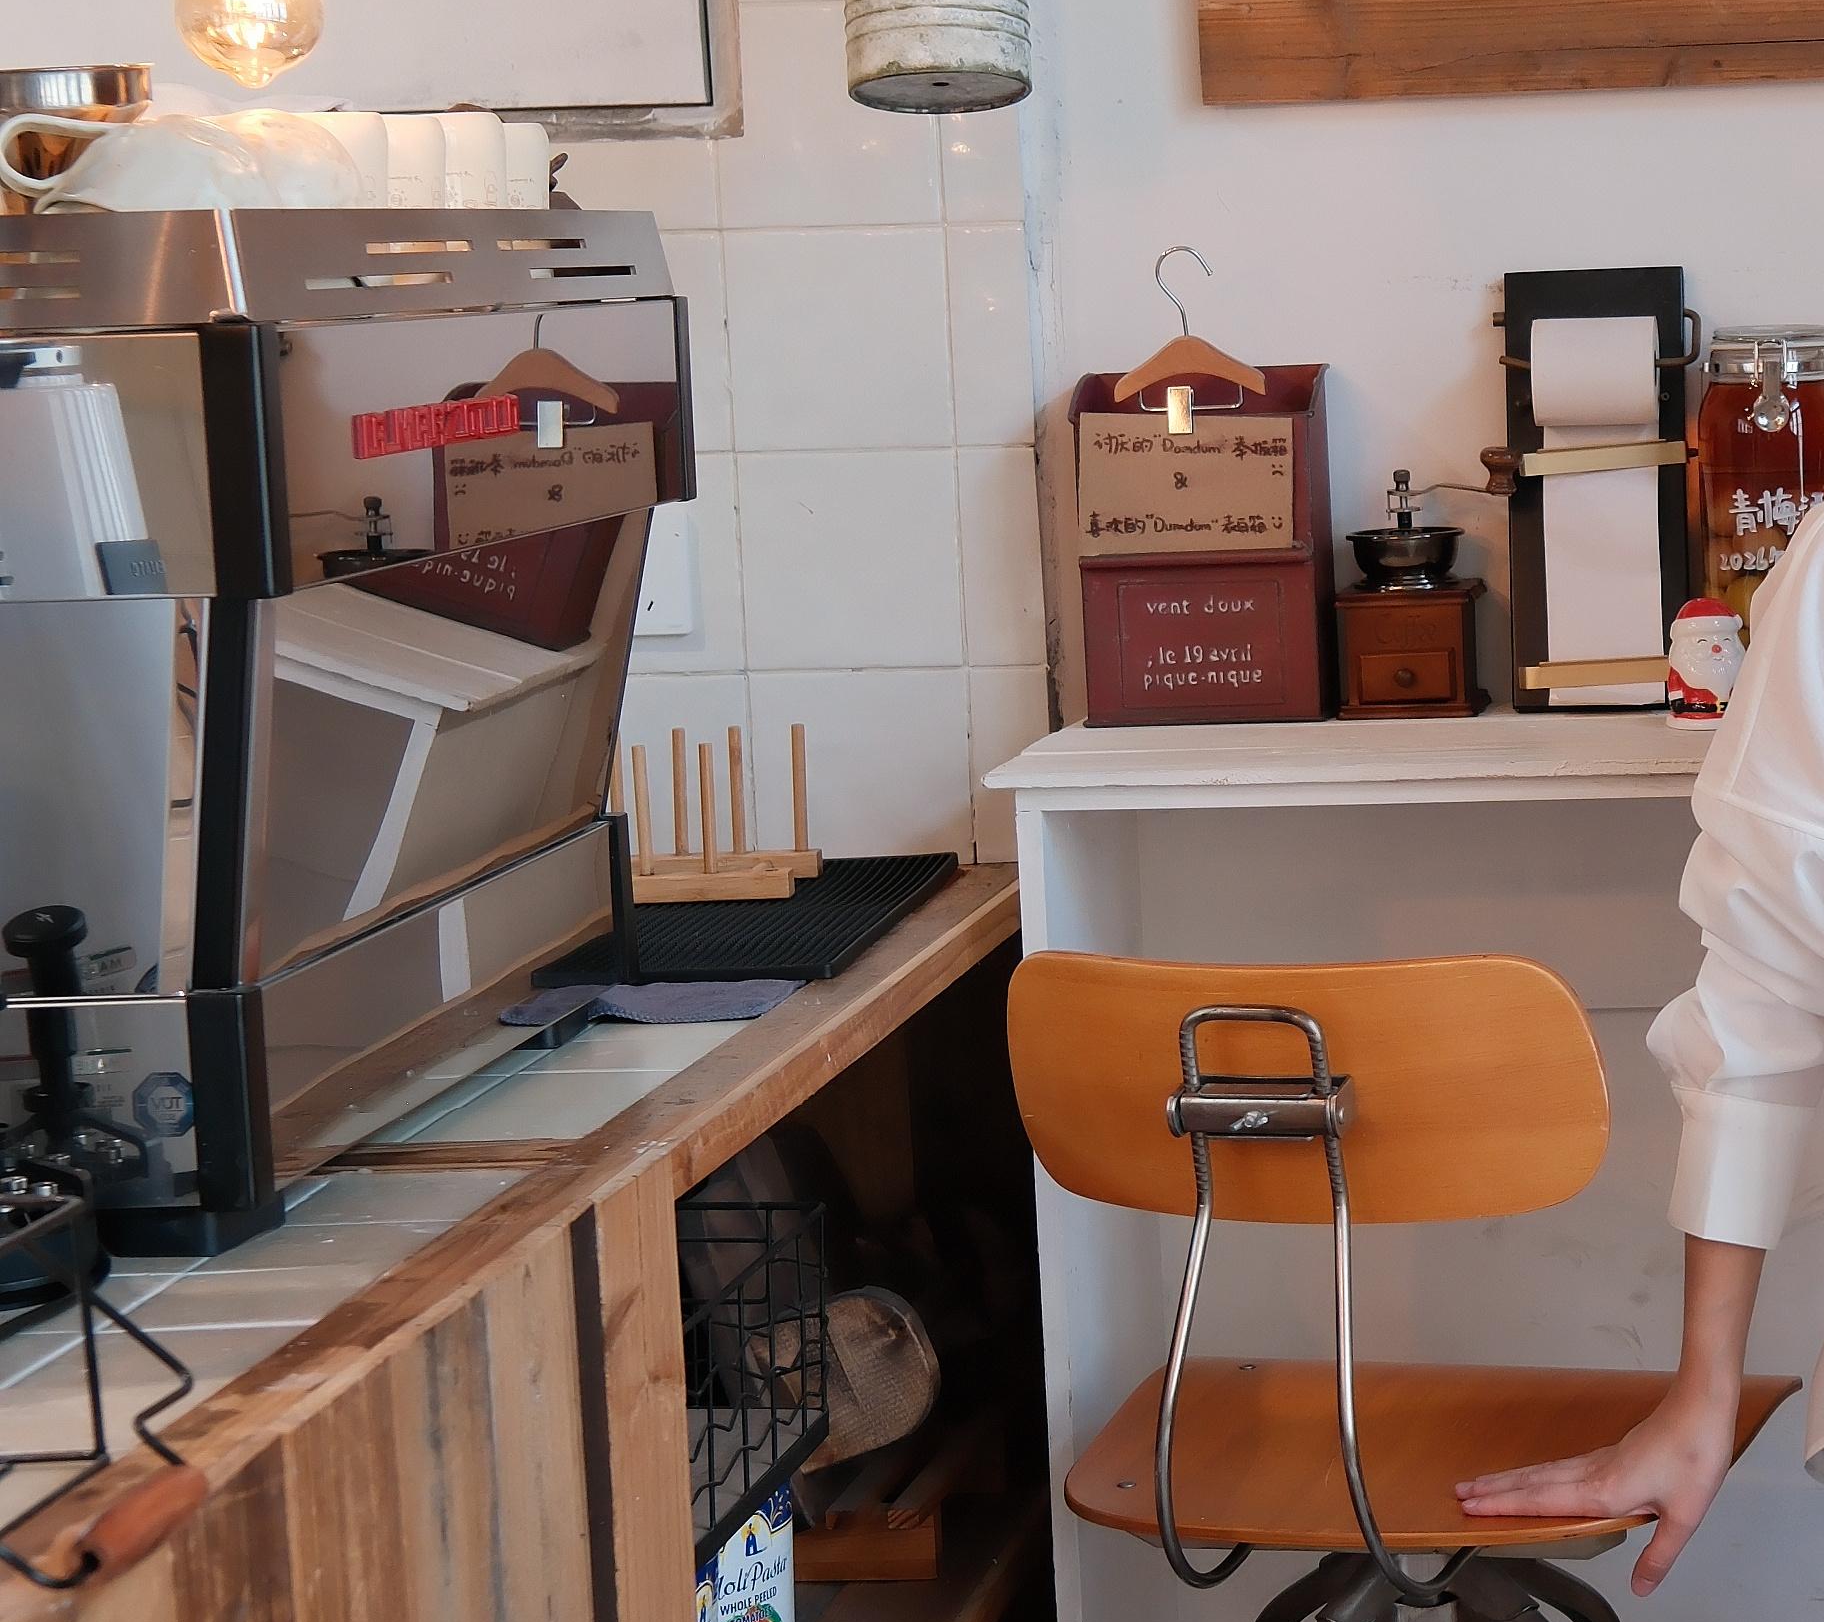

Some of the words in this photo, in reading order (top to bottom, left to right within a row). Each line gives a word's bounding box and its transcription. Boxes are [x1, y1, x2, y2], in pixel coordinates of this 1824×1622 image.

[1173, 472, 1189, 490] &
[1146, 599, 1191, 614] vent
[1204, 595, 1255, 613] doux
[1159, 646, 1176, 665] le
[1184, 645, 1204, 664] 19
[1209, 644, 1252, 662] avril
[1144, 669, 1263, 691] pique-nique
[720, 1596, 752, 1616] WHOLE
[754, 1585, 777, 1604] PEELED
